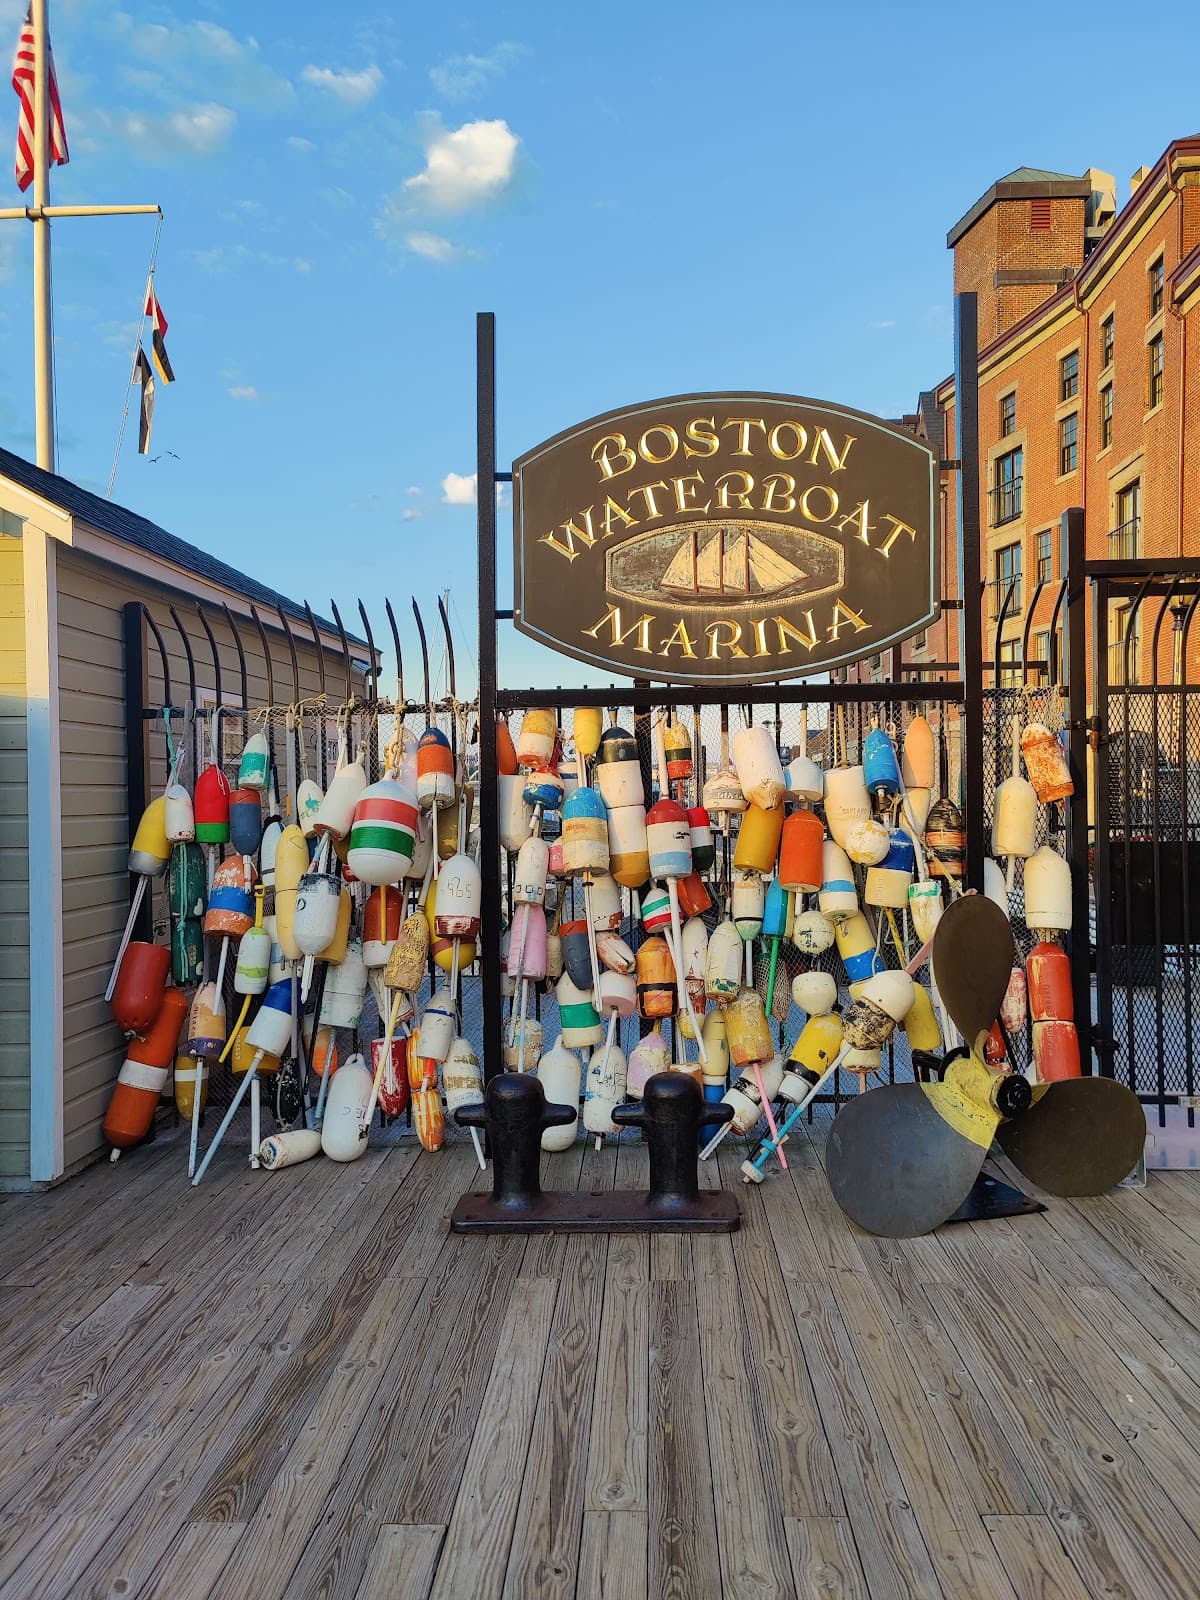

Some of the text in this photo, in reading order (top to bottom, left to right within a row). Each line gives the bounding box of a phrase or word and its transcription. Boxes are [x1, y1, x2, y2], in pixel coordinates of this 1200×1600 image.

[591, 416, 858, 483] BOSTON
[536, 470, 917, 563] WATERBOAT
[581, 598, 873, 660] MARINA
